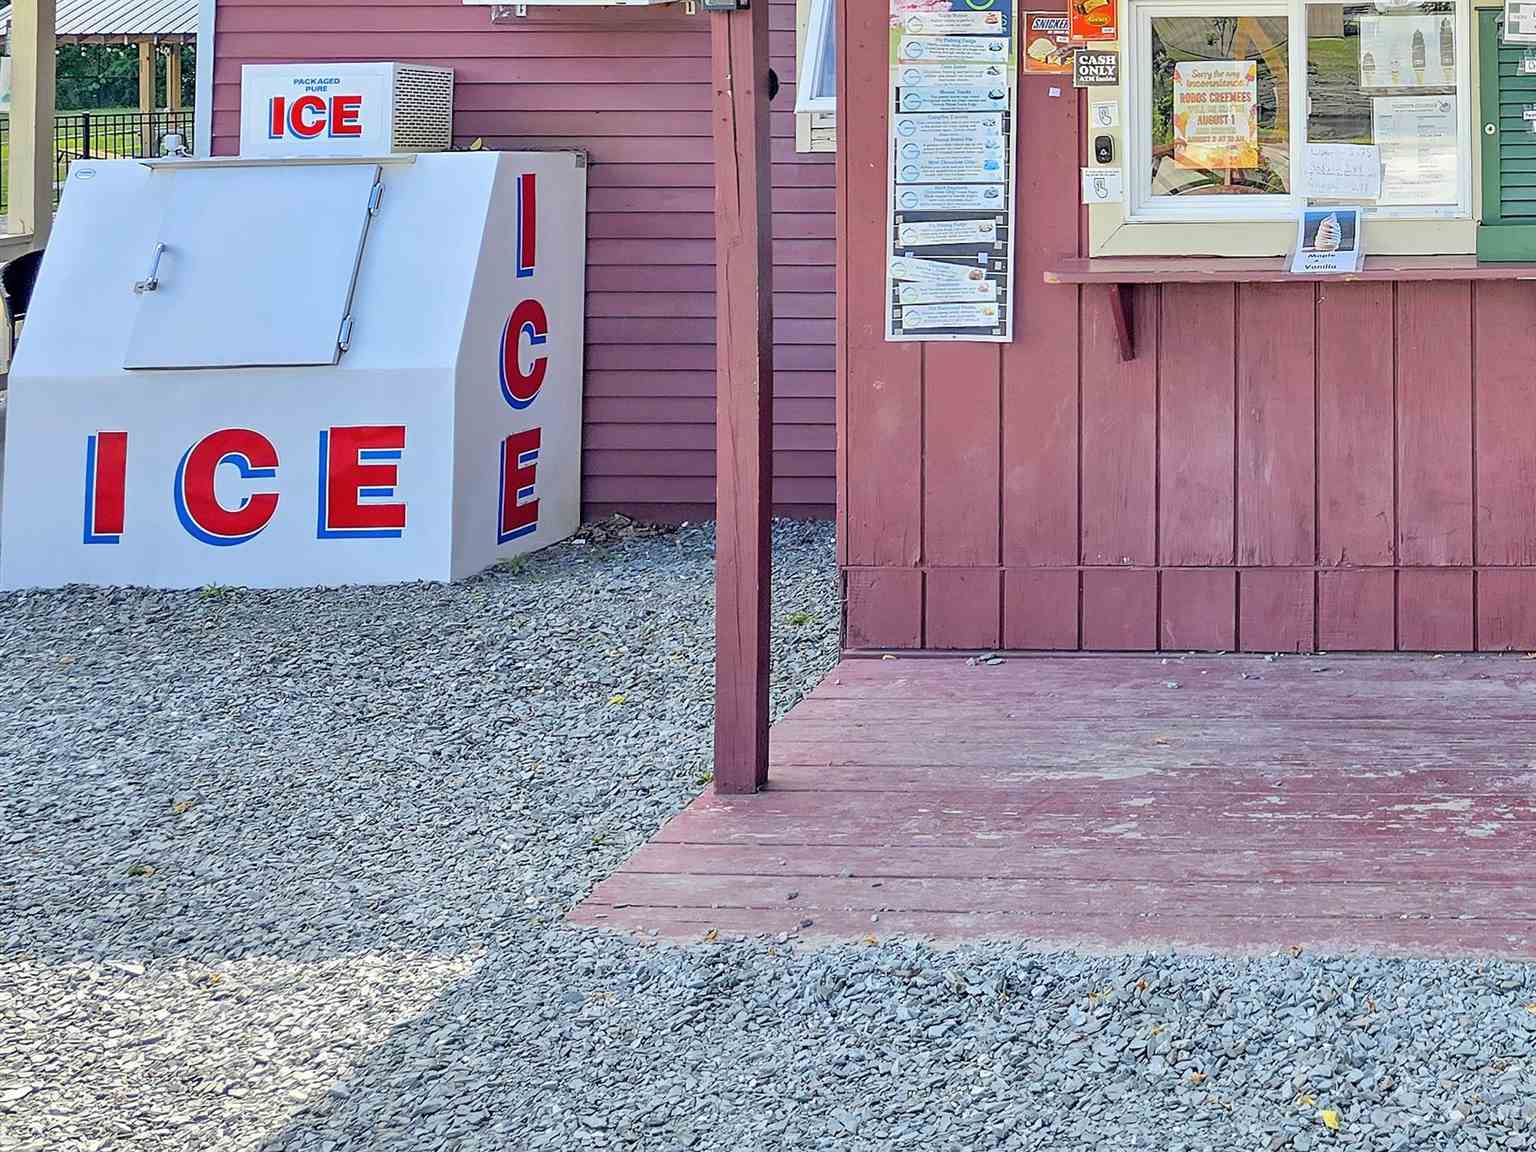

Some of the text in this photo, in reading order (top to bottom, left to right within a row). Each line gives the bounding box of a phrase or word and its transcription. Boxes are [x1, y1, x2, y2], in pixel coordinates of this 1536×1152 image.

[1033, 17, 1069, 30] SNICKER
[1078, 55, 1116, 65] CASH
[1078, 65, 1116, 76] ONLY
[293, 77, 340, 86] PACKAGED
[305, 85, 328, 93] PURE
[268, 94, 363, 140] ICE
[1197, 114, 1228, 126] AUGUST
[497, 172, 549, 545] ICE
[82, 424, 406, 547] ICE
